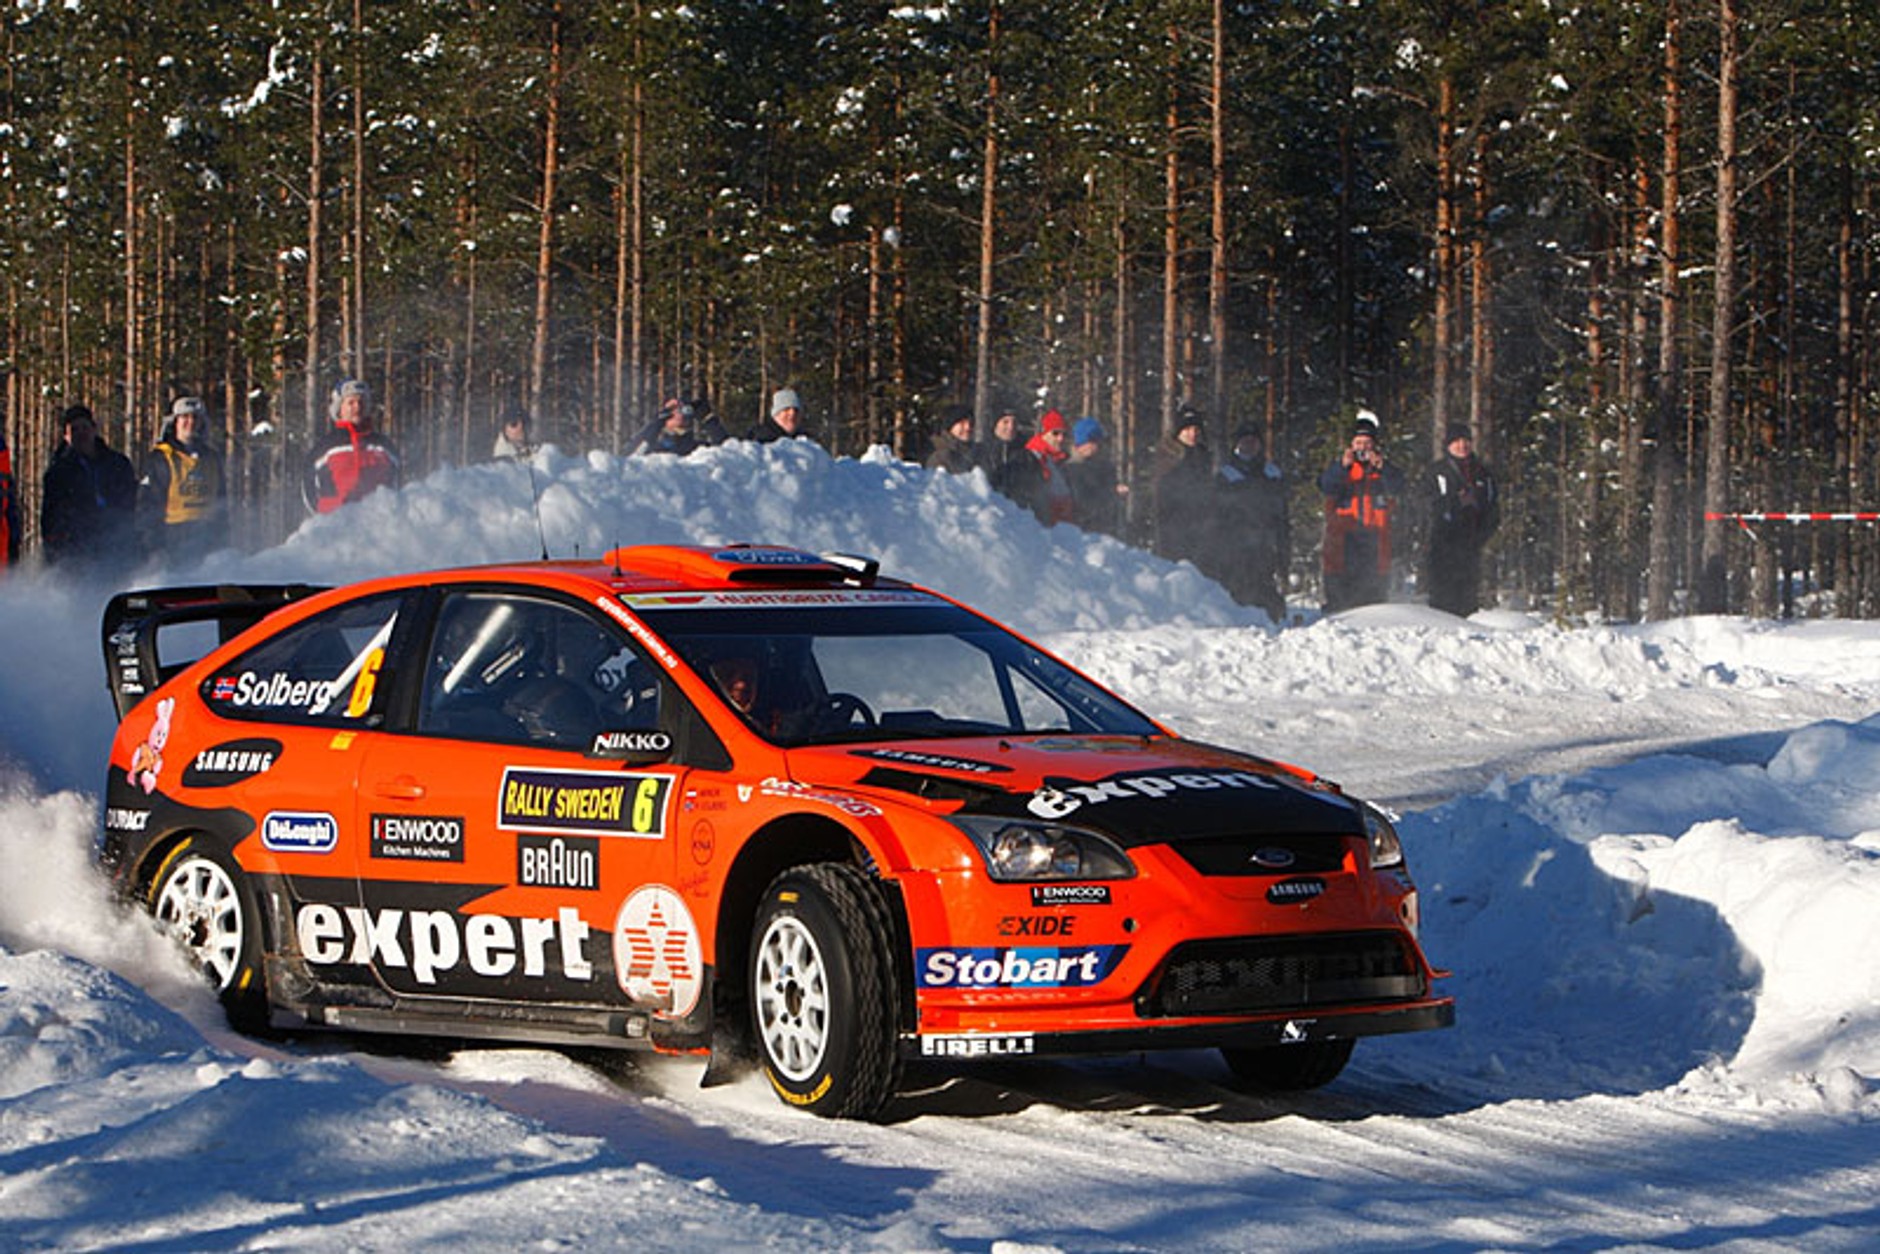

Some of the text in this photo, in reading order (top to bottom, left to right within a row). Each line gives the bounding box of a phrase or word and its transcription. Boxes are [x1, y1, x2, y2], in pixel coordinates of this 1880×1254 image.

[233, 672, 332, 715] Solberg
[343, 647, 385, 717] 6
[594, 732, 671, 753] NIKKO
[873, 748, 992, 772] SAMSUNG
[195, 751, 273, 772] SAMSUNG
[505, 777, 659, 833] RALLY SWEDEN 6
[1027, 772, 1279, 820] expert
[373, 818, 460, 844] KENWOOD
[522, 838, 594, 887] BRAUN
[1034, 886, 1107, 899] KENWOOD
[999, 916, 1077, 936] EXIDE
[297, 903, 592, 985] expert
[923, 951, 1099, 986] Stobart
